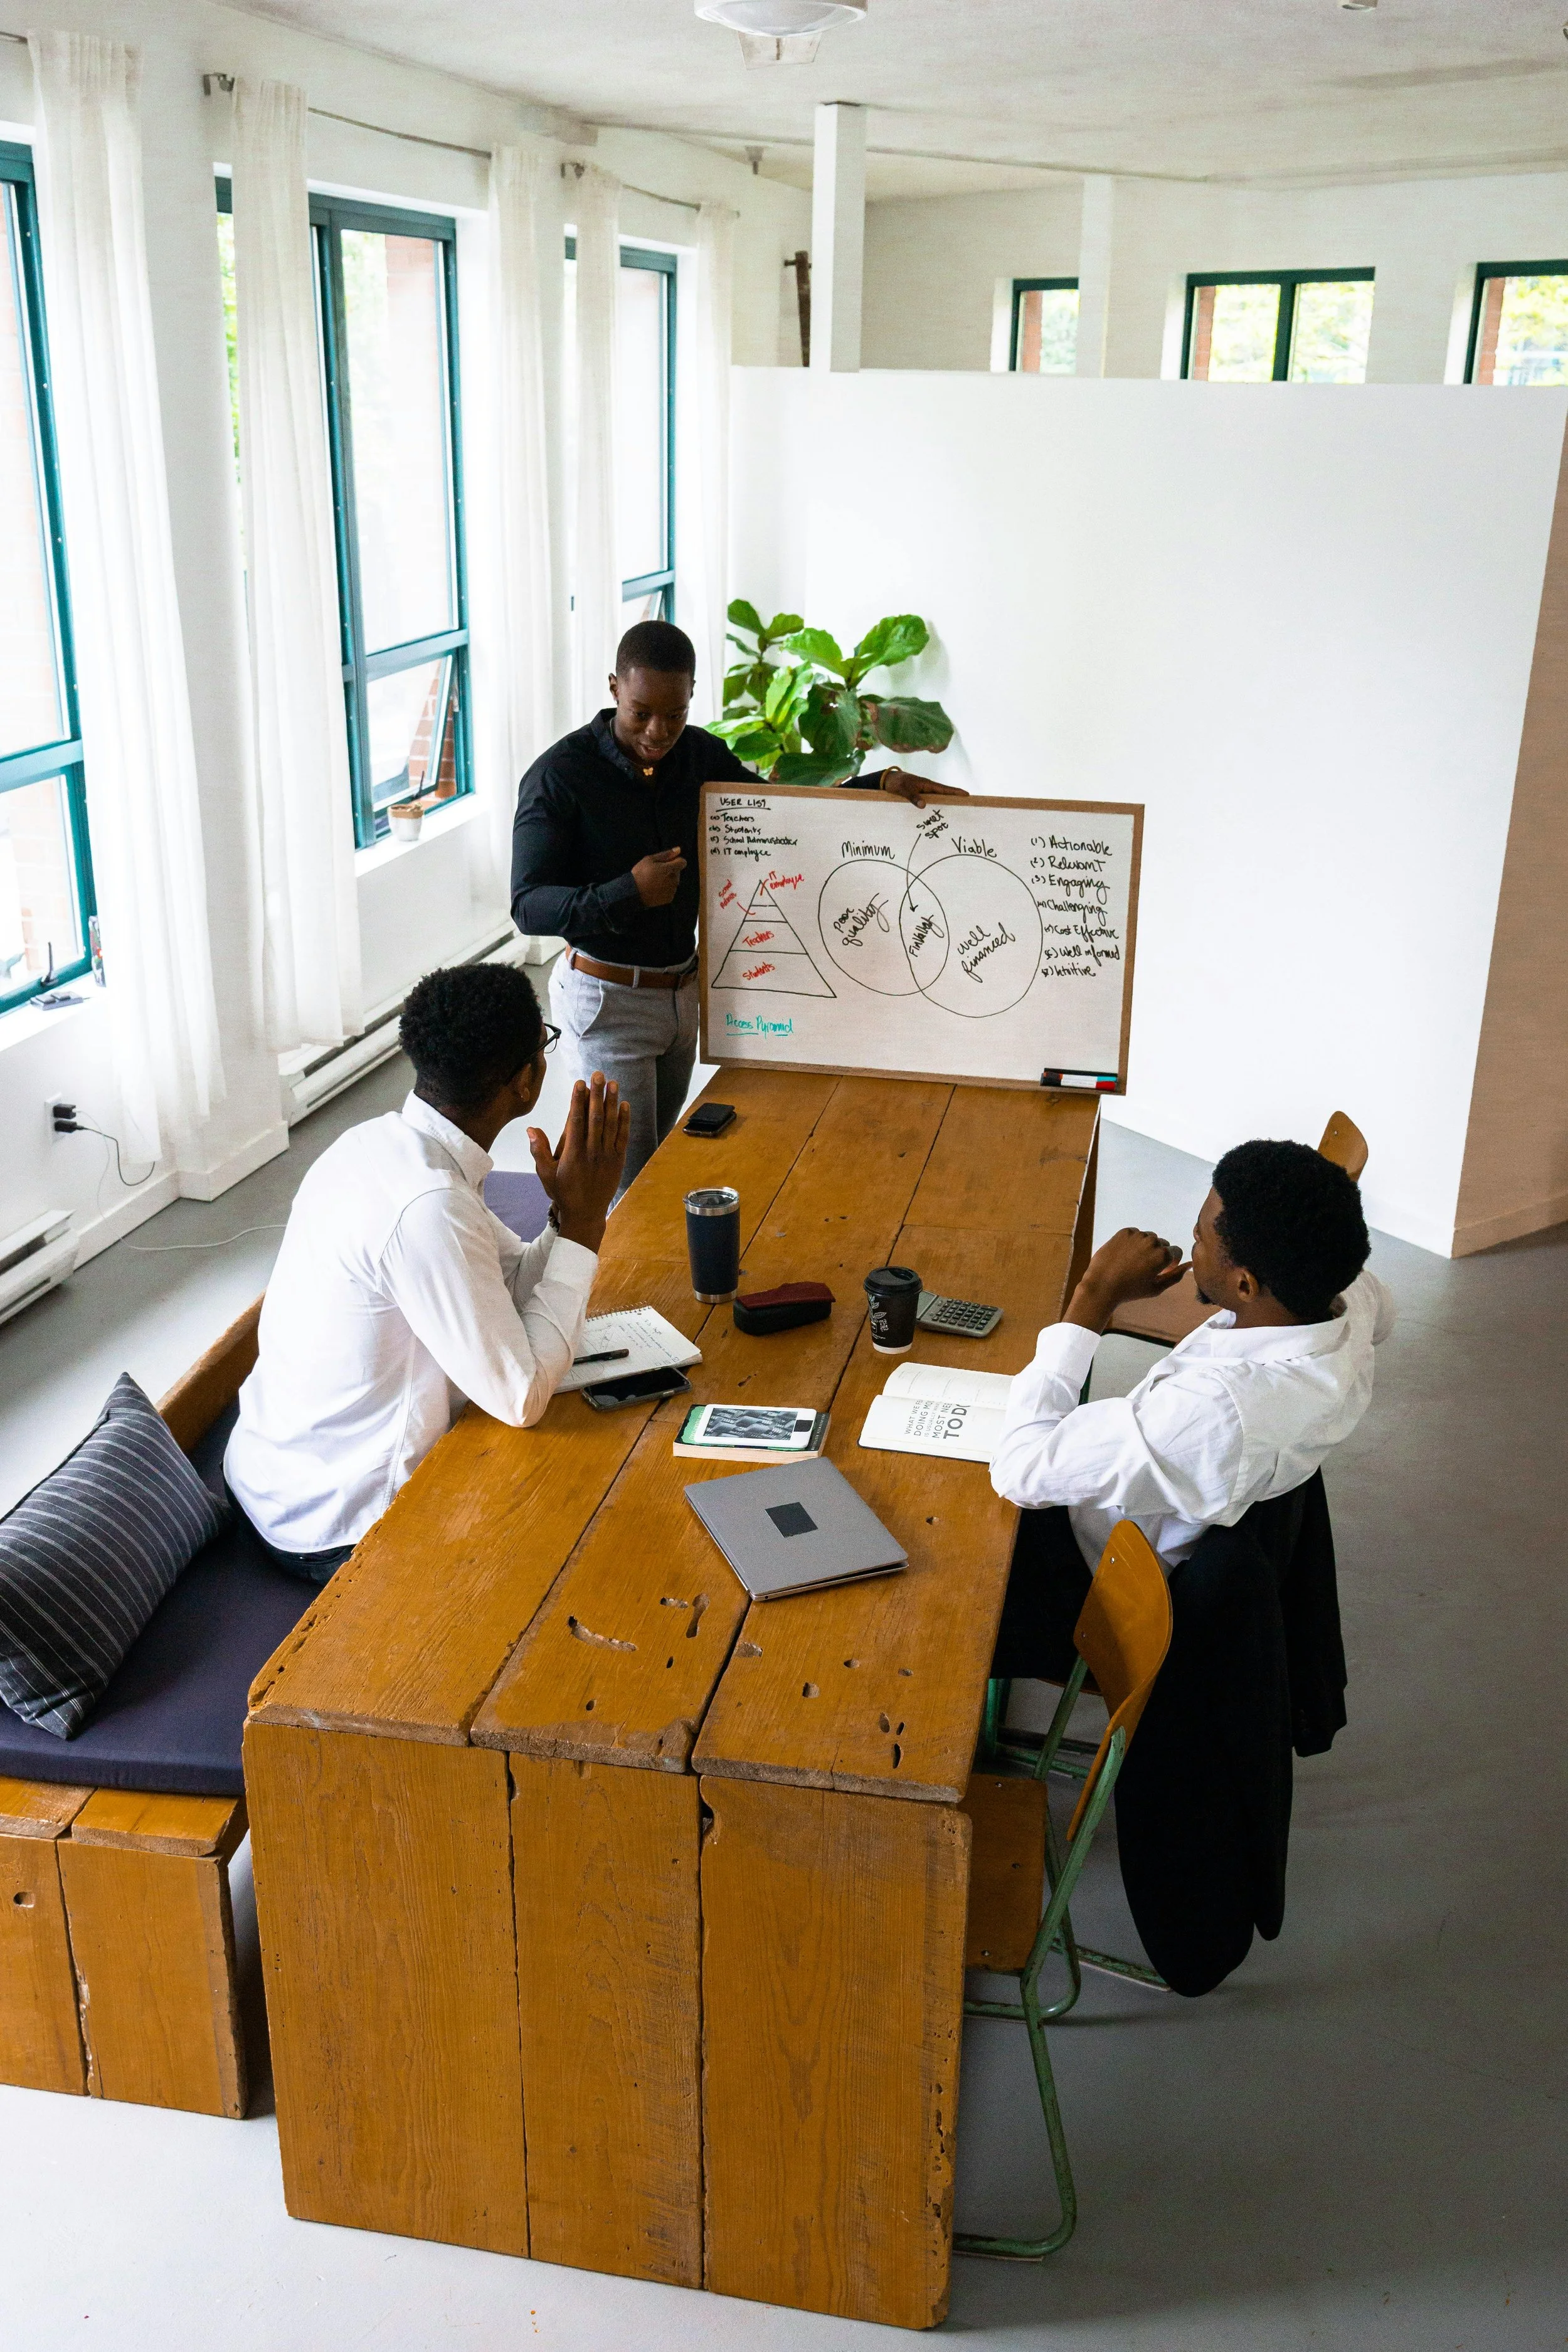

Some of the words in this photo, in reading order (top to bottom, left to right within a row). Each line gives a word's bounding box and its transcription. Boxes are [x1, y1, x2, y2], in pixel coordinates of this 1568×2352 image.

[720, 797, 742, 806] USER
[747, 798, 766, 808] LIST
[721, 813, 755, 822] Teachers
[916, 809, 944, 830] sweet
[724, 824, 761, 835] Students
[924, 822, 949, 839] spot
[723, 835, 744, 845] School
[951, 836, 997, 858] Viable
[1030, 836, 1046, 848] (1)
[1049, 835, 1113, 856] Actionable
[724, 847, 732, 856] IT
[841, 840, 896, 860] Minimum
[1030, 857, 1045, 868] (2)
[768, 871, 777, 881] IT
[1031, 874, 1046, 884] (3)
[1049, 874, 1111, 905] Engaging
[842, 893, 890, 946] quality
[1047, 899, 1108, 927] Challenging
[742, 931, 775, 947] Teachers
[1054, 924, 1071, 935] Cost
[1059, 945, 1083, 958] Well
[742, 961, 776, 980] Students
[1054, 962, 1096, 977] Intuitive
[725, 1012, 754, 1029] Access
[756, 1015, 794, 1039] Pyramid
[951, 1404, 972, 1416] D
[904, 1416, 916, 1434] WHAT
[911, 1406, 920, 1414] WE
[913, 1411, 928, 1436] DOING
[926, 1412, 936, 1432] USUALLY
[931, 1414, 946, 1439] MOST
[943, 1418, 963, 1439] TO
